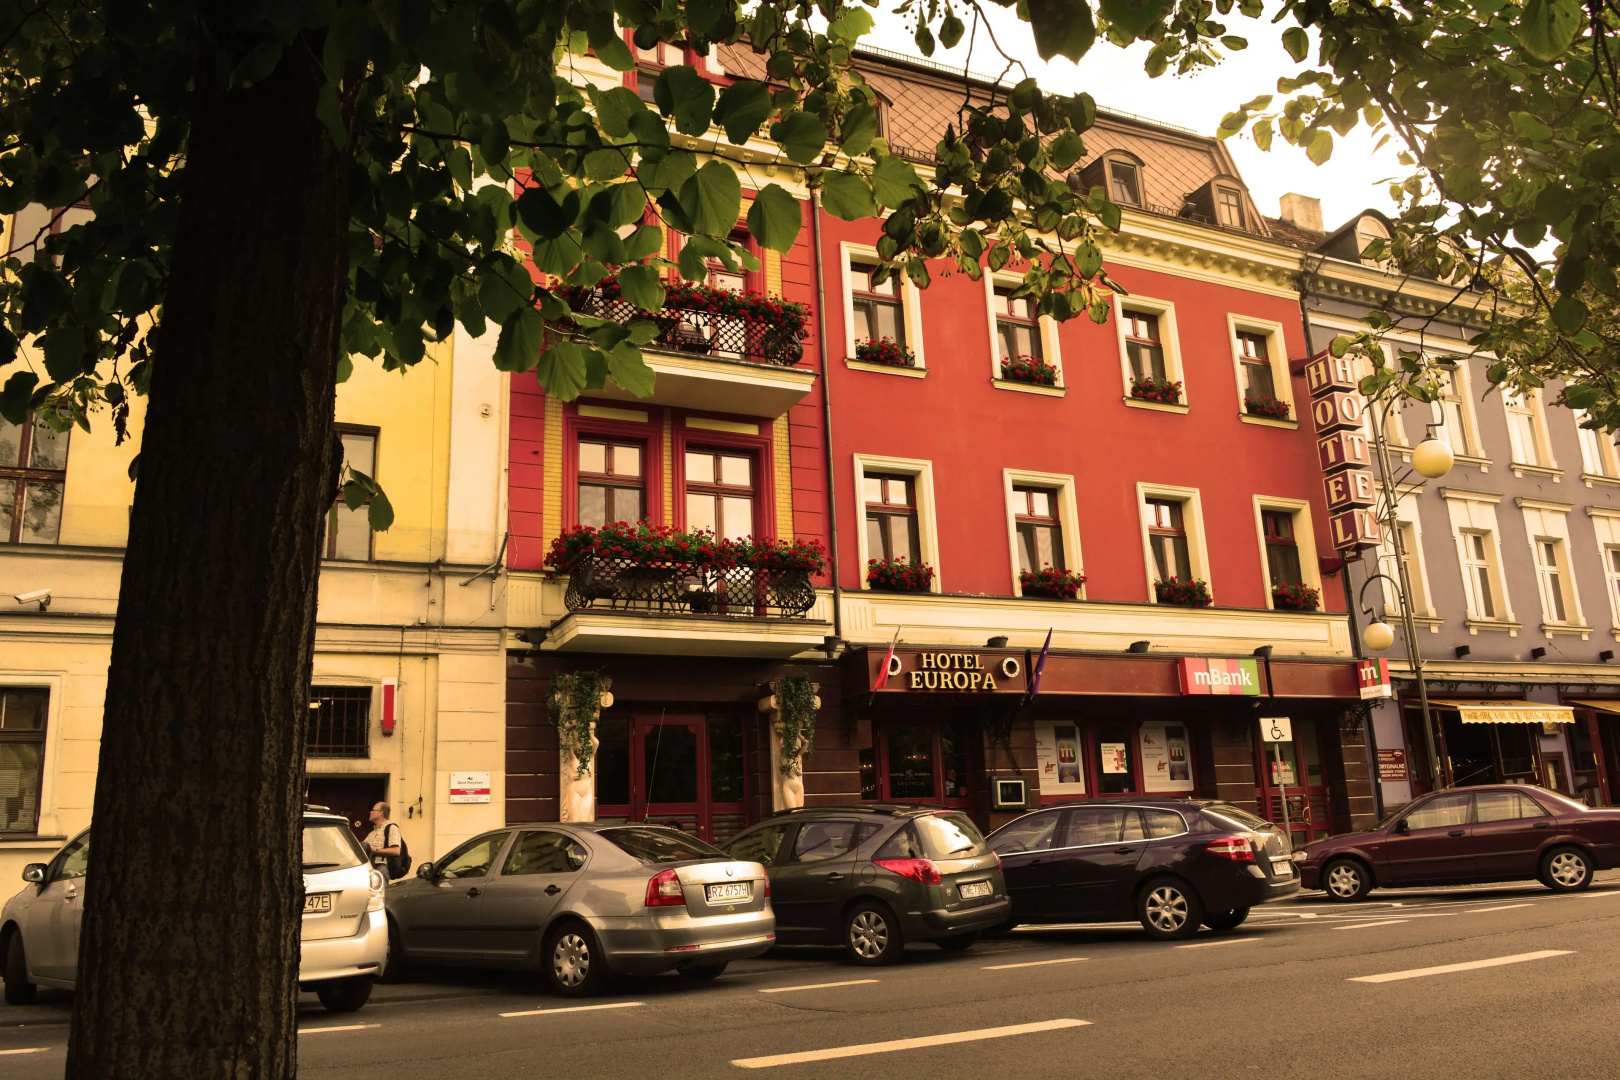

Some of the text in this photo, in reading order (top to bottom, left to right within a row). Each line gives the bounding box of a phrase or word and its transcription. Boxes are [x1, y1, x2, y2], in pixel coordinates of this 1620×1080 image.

[1309, 360, 1353, 544] HOTEL
[1334, 357, 1379, 540] HOTEL
[921, 652, 985, 670] HOTEL
[910, 671, 998, 690] EUROPA
[1193, 668, 1253, 686] mBank
[1360, 666, 1379, 681] m
[711, 886, 724, 898] RZ
[304, 895, 329, 909] 47E
